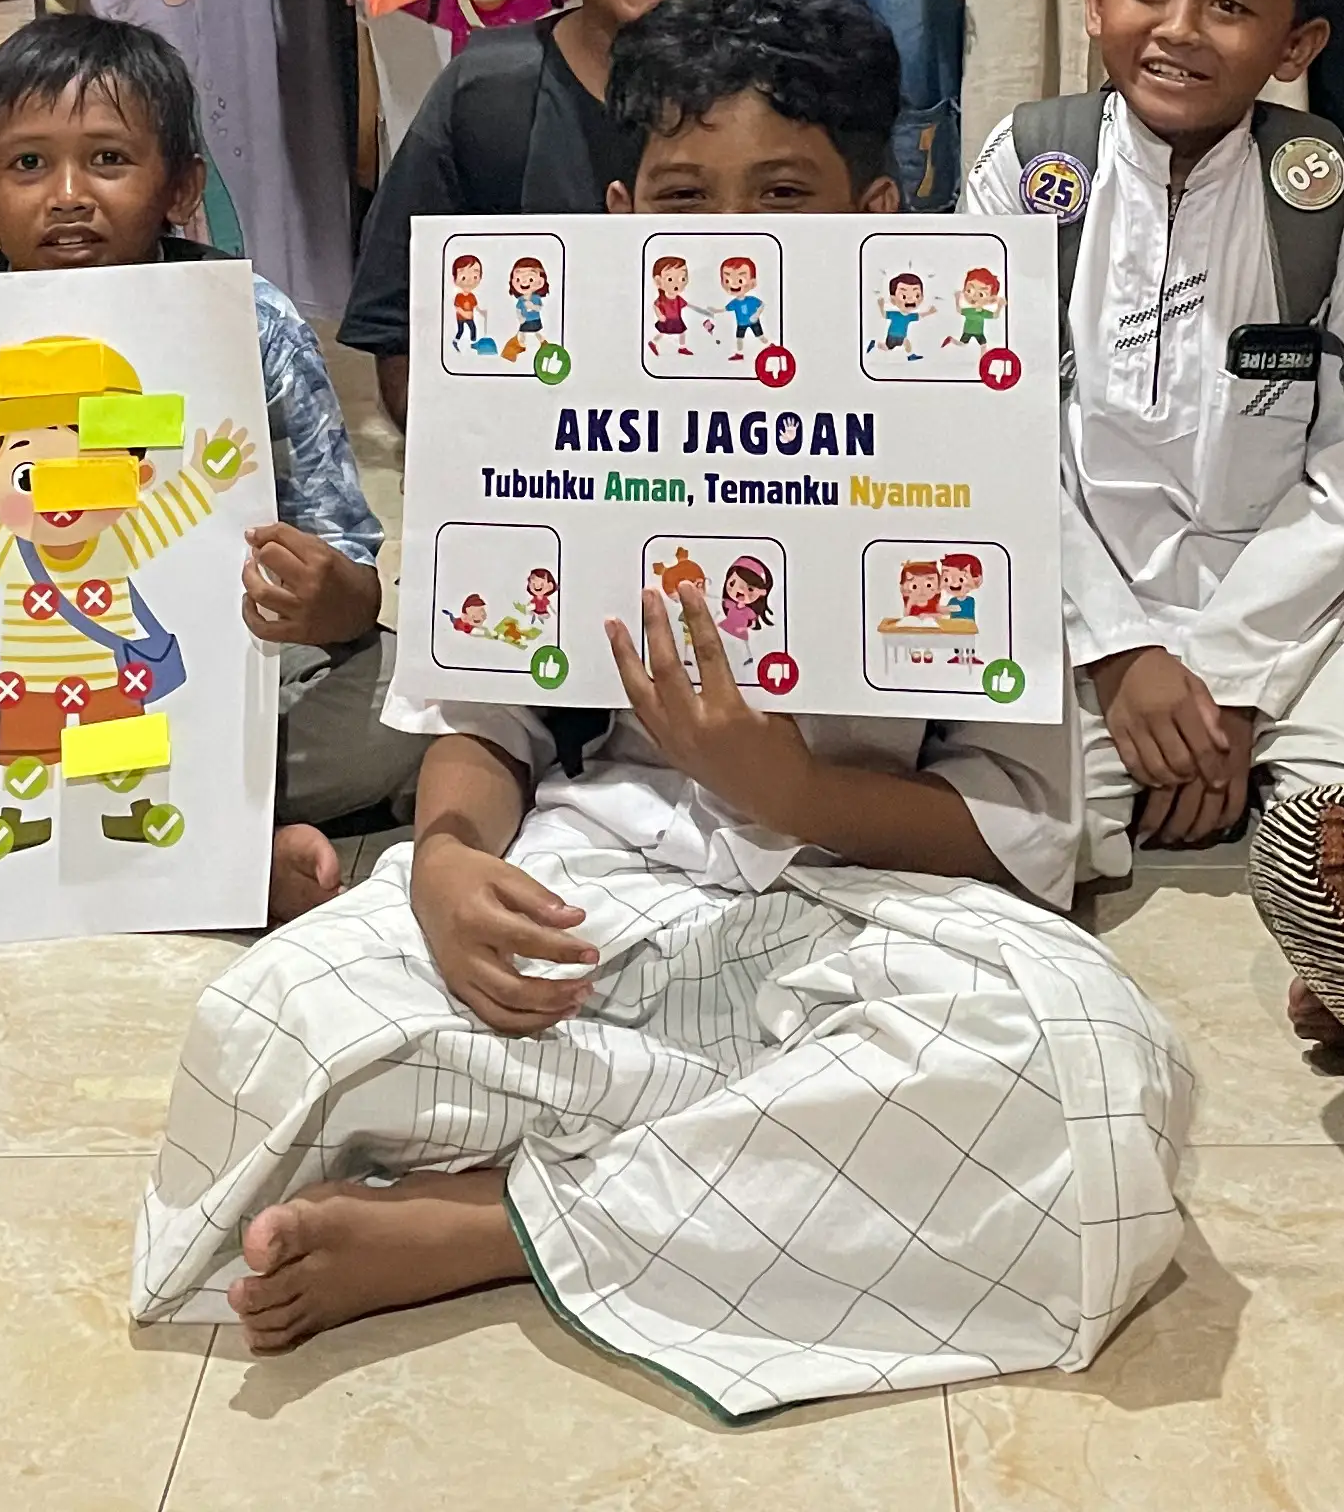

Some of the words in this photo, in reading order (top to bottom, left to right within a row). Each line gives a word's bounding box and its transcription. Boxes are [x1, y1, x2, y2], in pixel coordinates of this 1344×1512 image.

[1035, 172, 1074, 207] 25
[1287, 152, 1330, 190] 05
[554, 408, 659, 453] AKSI
[682, 410, 875, 456] JAGOAN
[482, 468, 594, 501] Tubuhku
[604, 471, 694, 506] Aman,
[705, 473, 839, 506] Temanku
[849, 477, 971, 509] Nyaman
